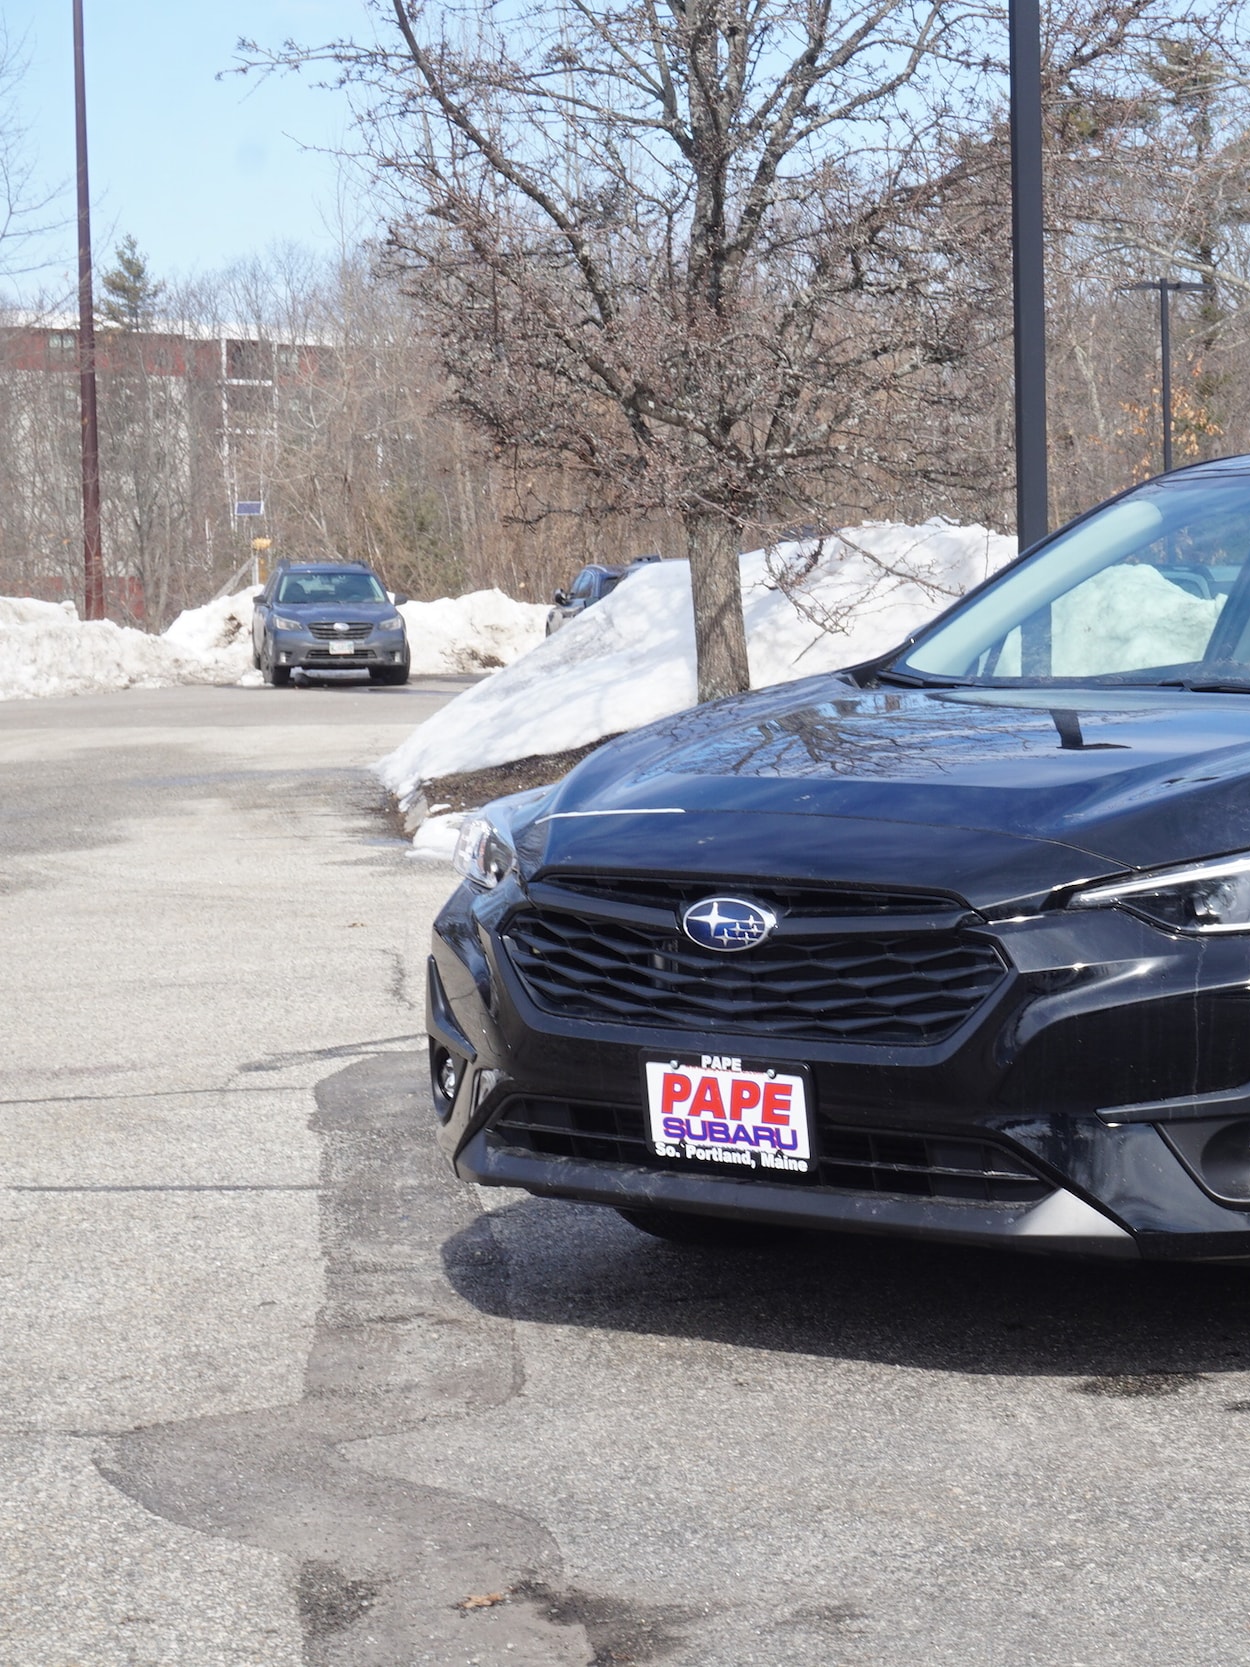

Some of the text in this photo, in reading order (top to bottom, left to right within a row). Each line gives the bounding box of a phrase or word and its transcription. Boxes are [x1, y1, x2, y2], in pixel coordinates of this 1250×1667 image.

[701, 1054, 742, 1072] PAPE
[661, 1072, 793, 1126] PAPE
[662, 1116, 798, 1151] SUBARU
[655, 1141, 809, 1173] So. Portland, Maine
